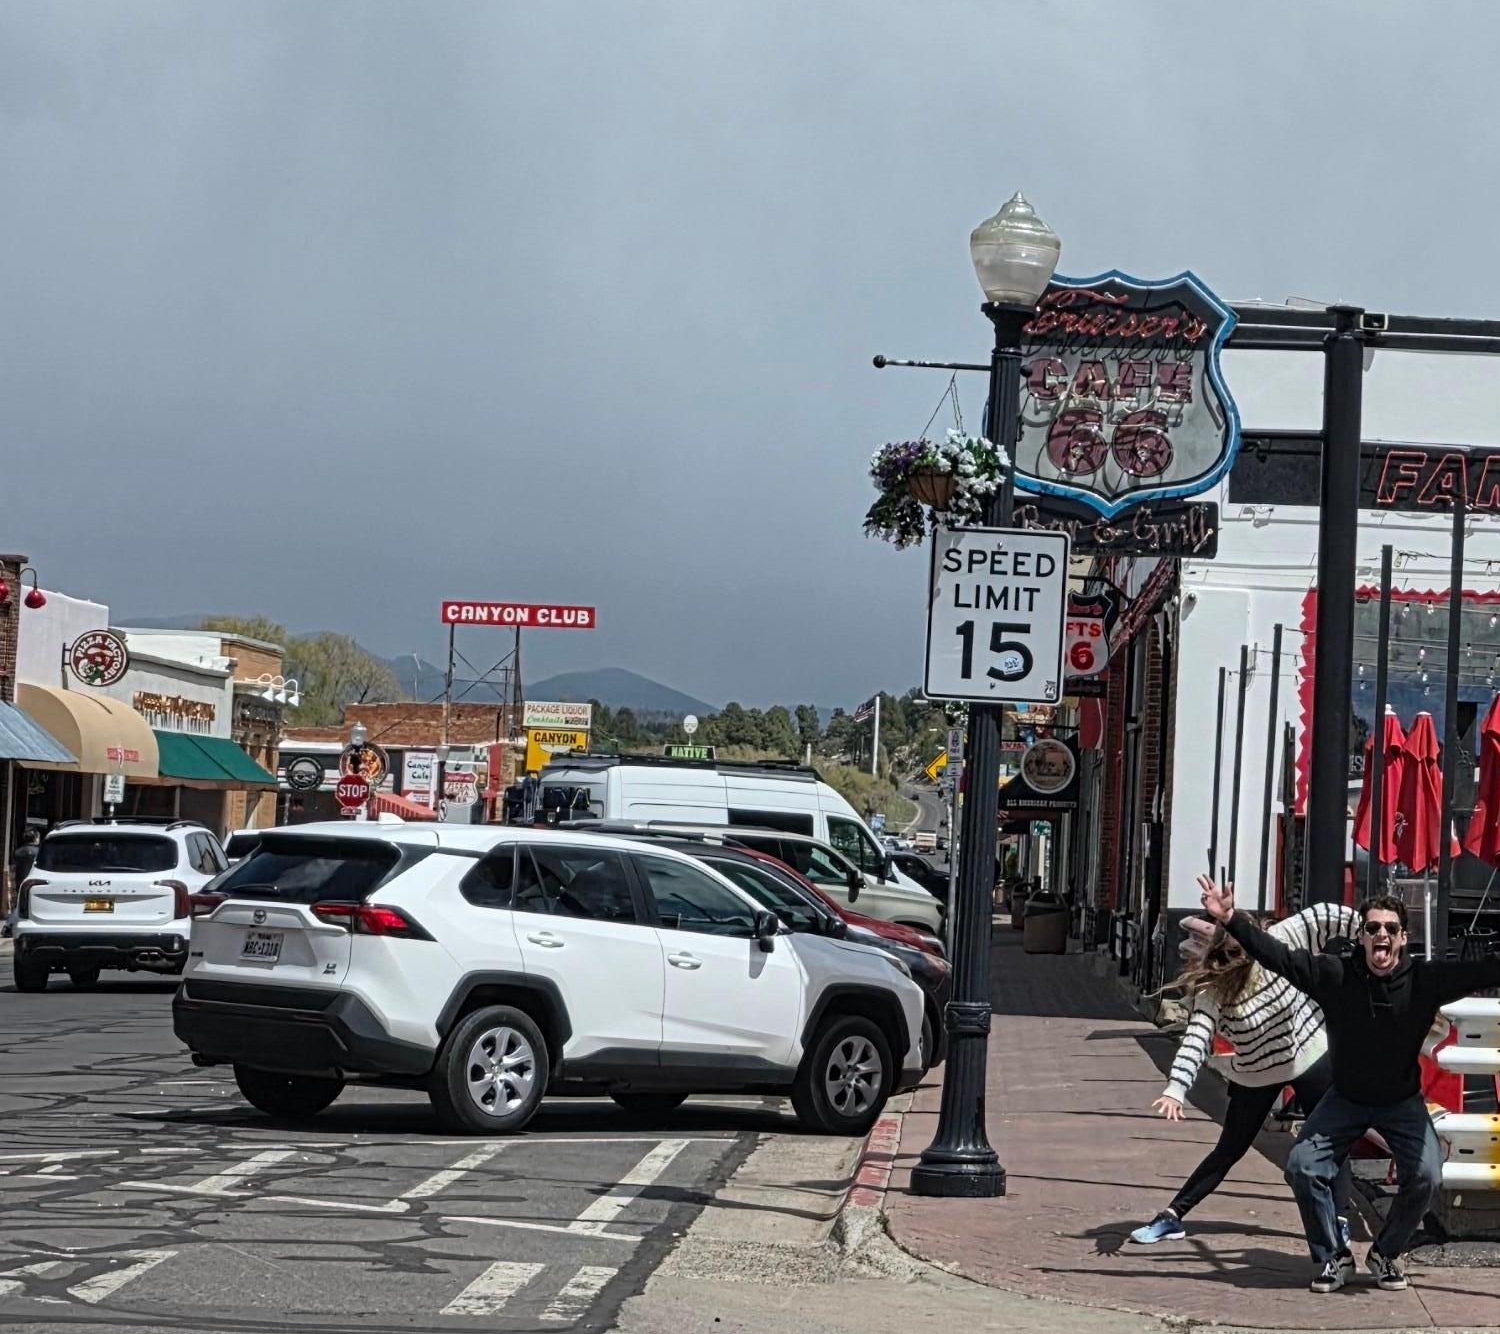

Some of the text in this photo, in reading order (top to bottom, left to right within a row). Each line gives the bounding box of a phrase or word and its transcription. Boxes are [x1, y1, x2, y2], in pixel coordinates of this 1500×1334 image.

[1027, 358, 1193, 403] CAFE
[1048, 408, 1174, 478] 66
[943, 547, 1056, 578] SPEED
[953, 583, 1041, 612] LIMIT
[447, 606, 590, 625] CANYON CLUB
[1066, 622, 1102, 638] FTS
[75, 635, 122, 681] PIZZA FACTORY
[955, 620, 1034, 682] 15
[1065, 641, 1095, 670] 6
[526, 705, 560, 715] PACKAGE
[534, 732, 577, 745] CANYON
[671, 746, 709, 759] NATIVE
[407, 761, 430, 772] Canyo
[338, 784, 368, 798] STOP
